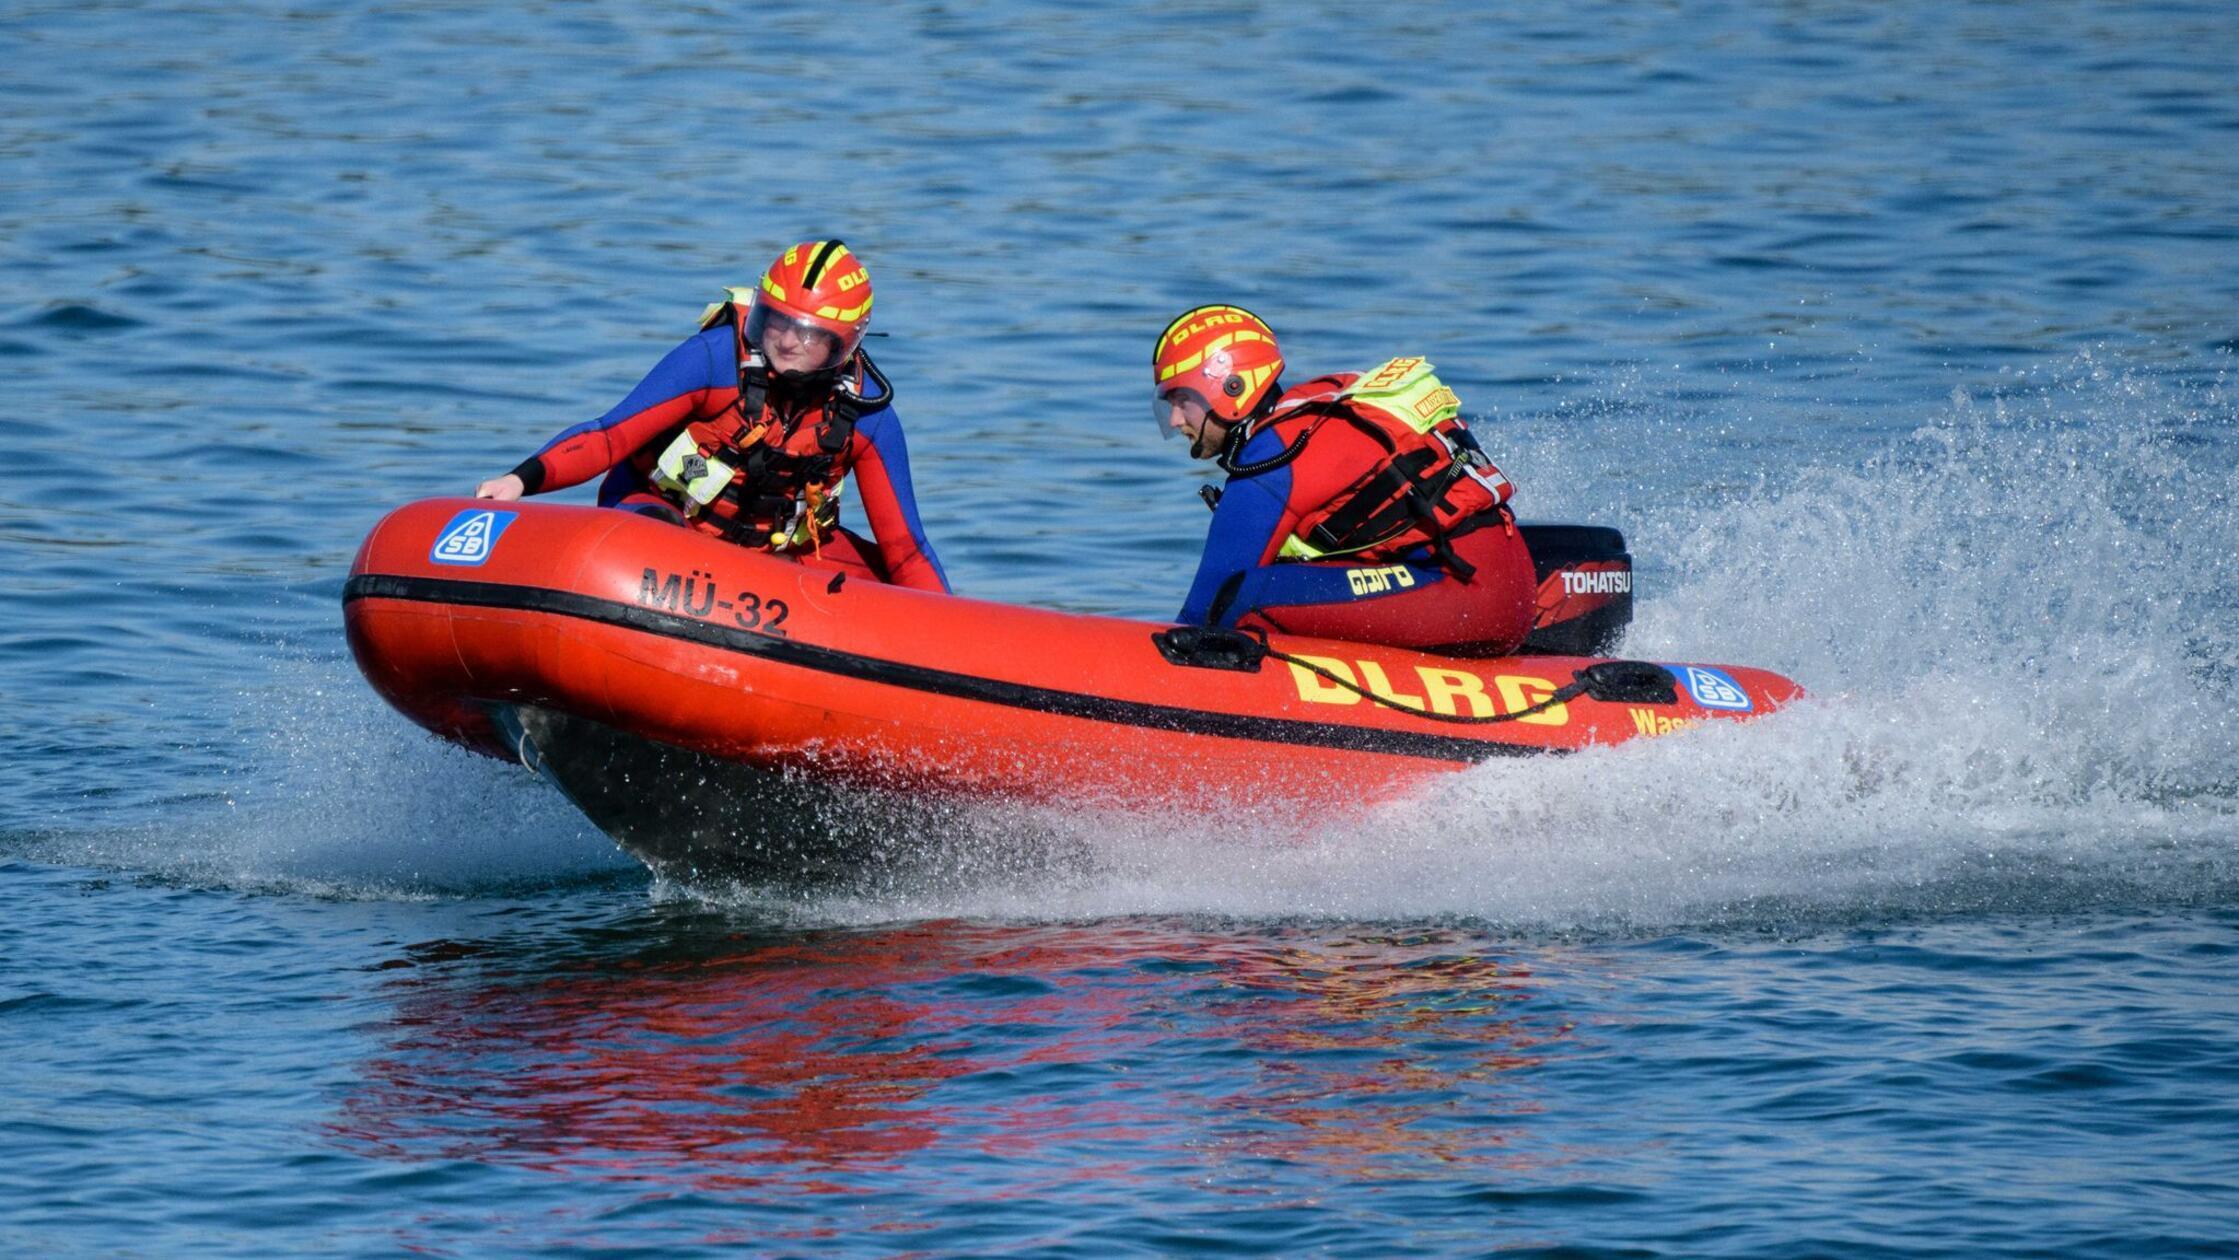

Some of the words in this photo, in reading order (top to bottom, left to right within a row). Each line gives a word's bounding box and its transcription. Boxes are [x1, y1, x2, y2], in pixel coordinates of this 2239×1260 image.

[1173, 314, 1243, 346] DLRG
[445, 536, 482, 554] SB
[1561, 571, 1631, 594] TOHATSU
[639, 567, 789, 637] MÜ-32
[1286, 654, 1569, 727] DLRG
[1699, 684, 1737, 701] SB
[1629, 707, 1698, 737] Was
